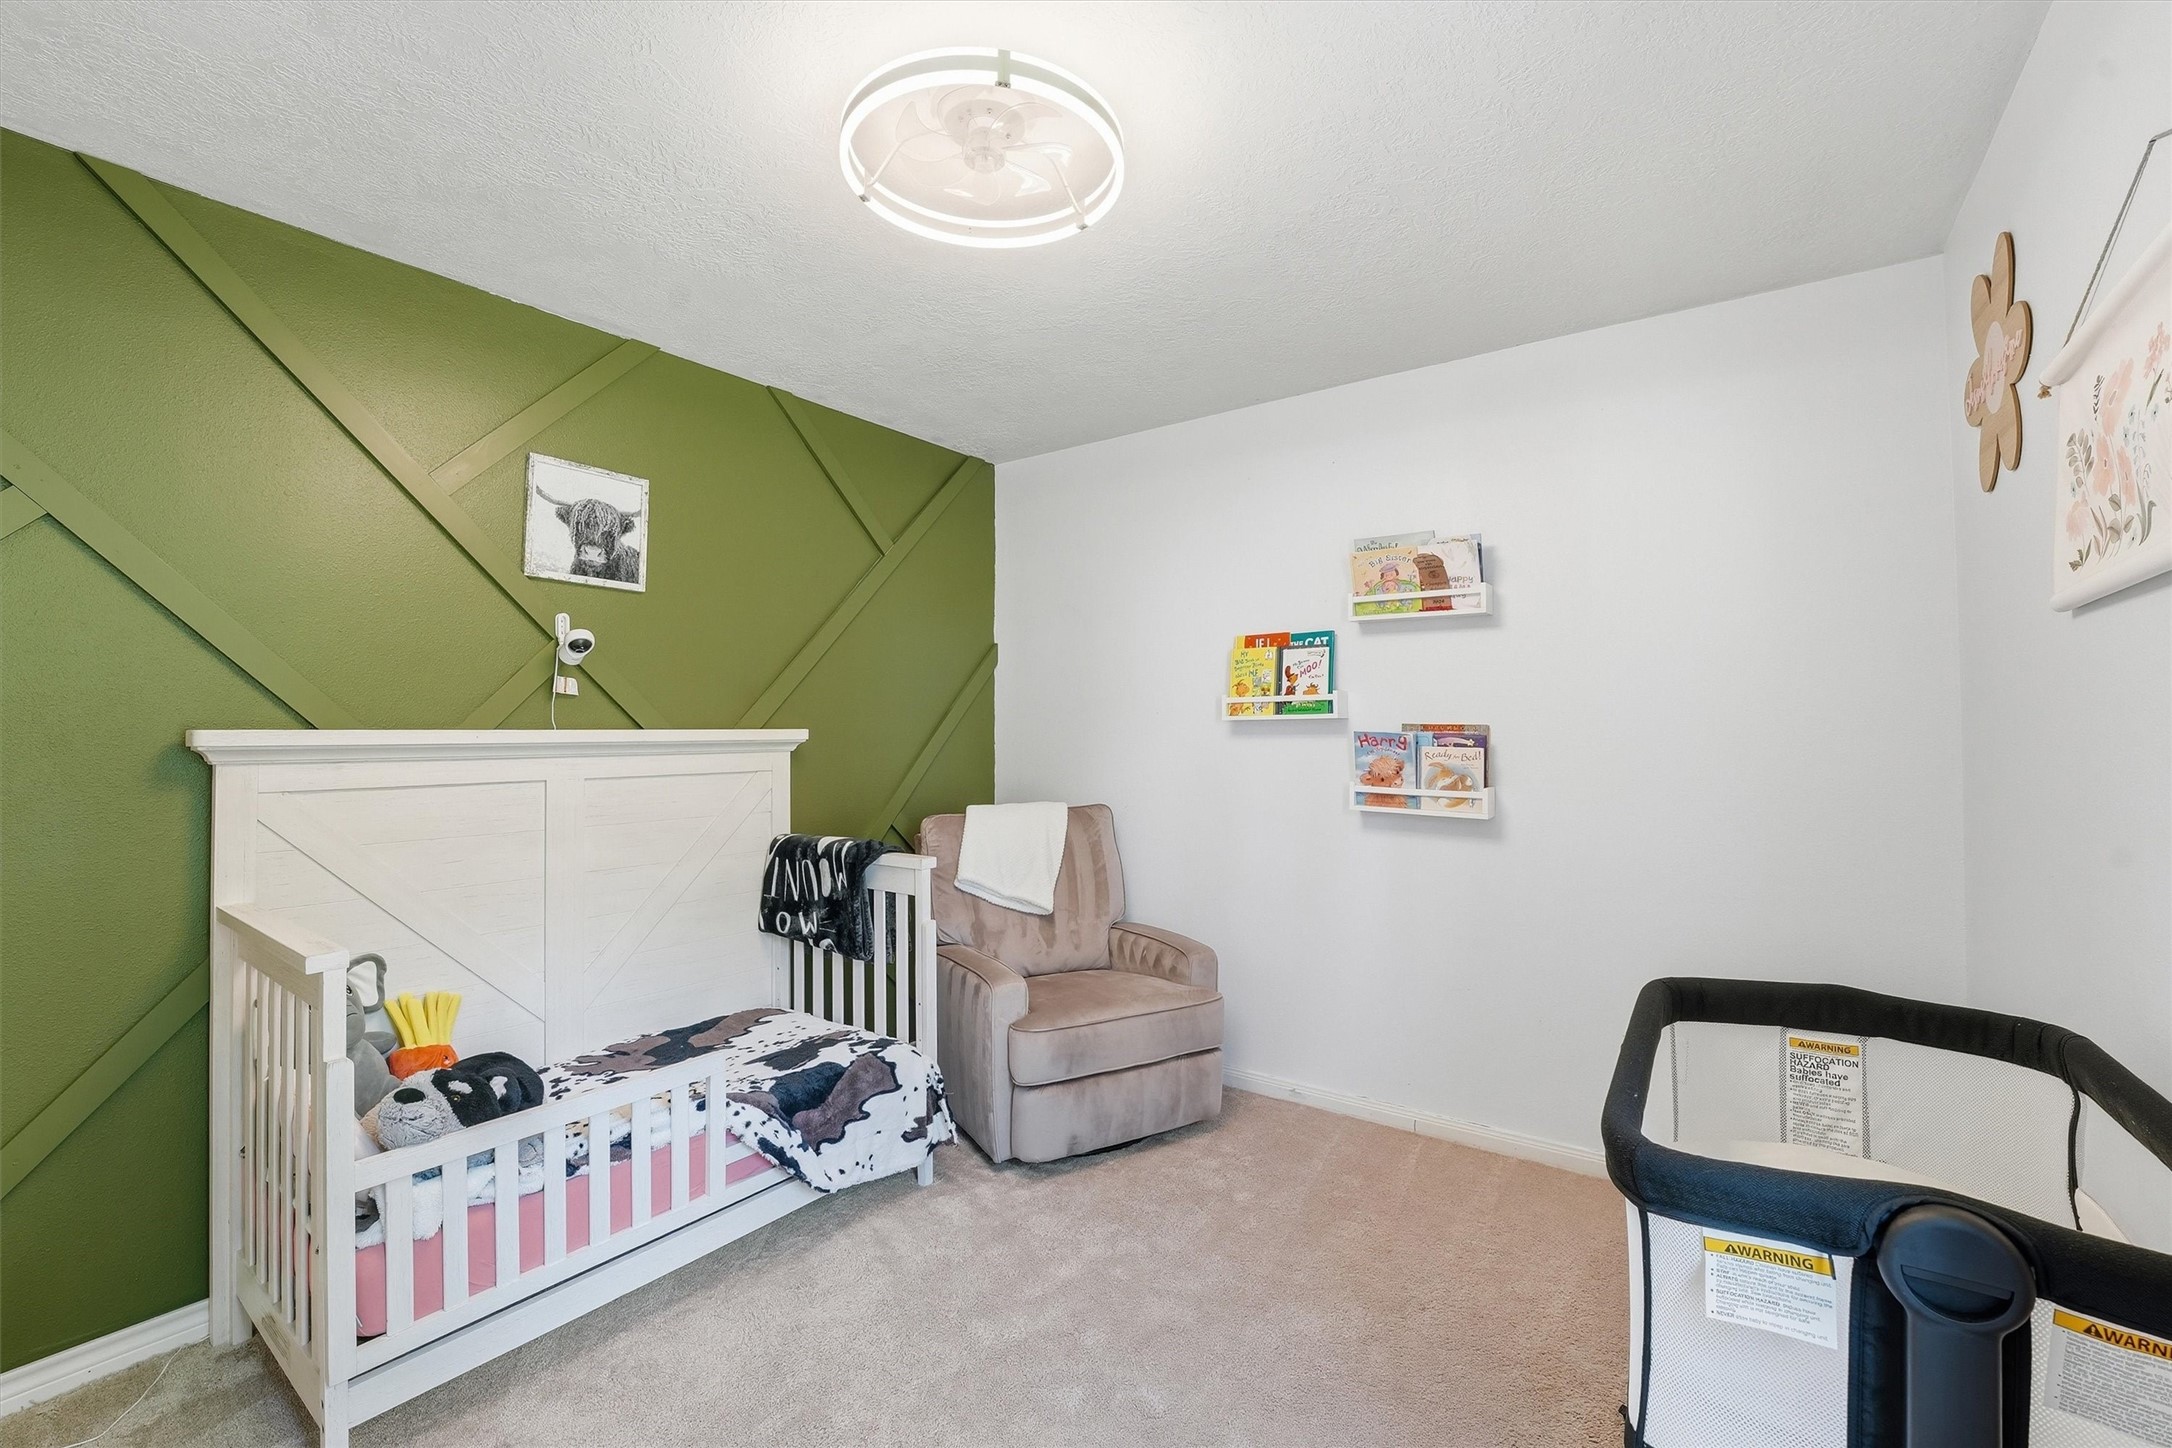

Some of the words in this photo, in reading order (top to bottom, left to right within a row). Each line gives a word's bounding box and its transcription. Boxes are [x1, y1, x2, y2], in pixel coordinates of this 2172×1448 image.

[1369, 557, 1384, 568] Big
[1385, 554, 1411, 564] Sister
[1304, 636, 1329, 646] CAT
[1300, 659, 1322, 678] MOO!
[1358, 733, 1407, 751] Harry
[1424, 749, 1452, 761] Ready
[1461, 750, 1482, 762] Bed!
[1805, 1042, 1851, 1054] WARNING
[1790, 1052, 1859, 1068] SUFFOCATION
[1790, 1059, 1829, 1071] HAZARD
[1790, 1065, 1822, 1077] Babies
[1825, 1071, 1849, 1081] have
[1790, 1074, 1840, 1087] suffocated
[1737, 1245, 1813, 1270] WARNING
